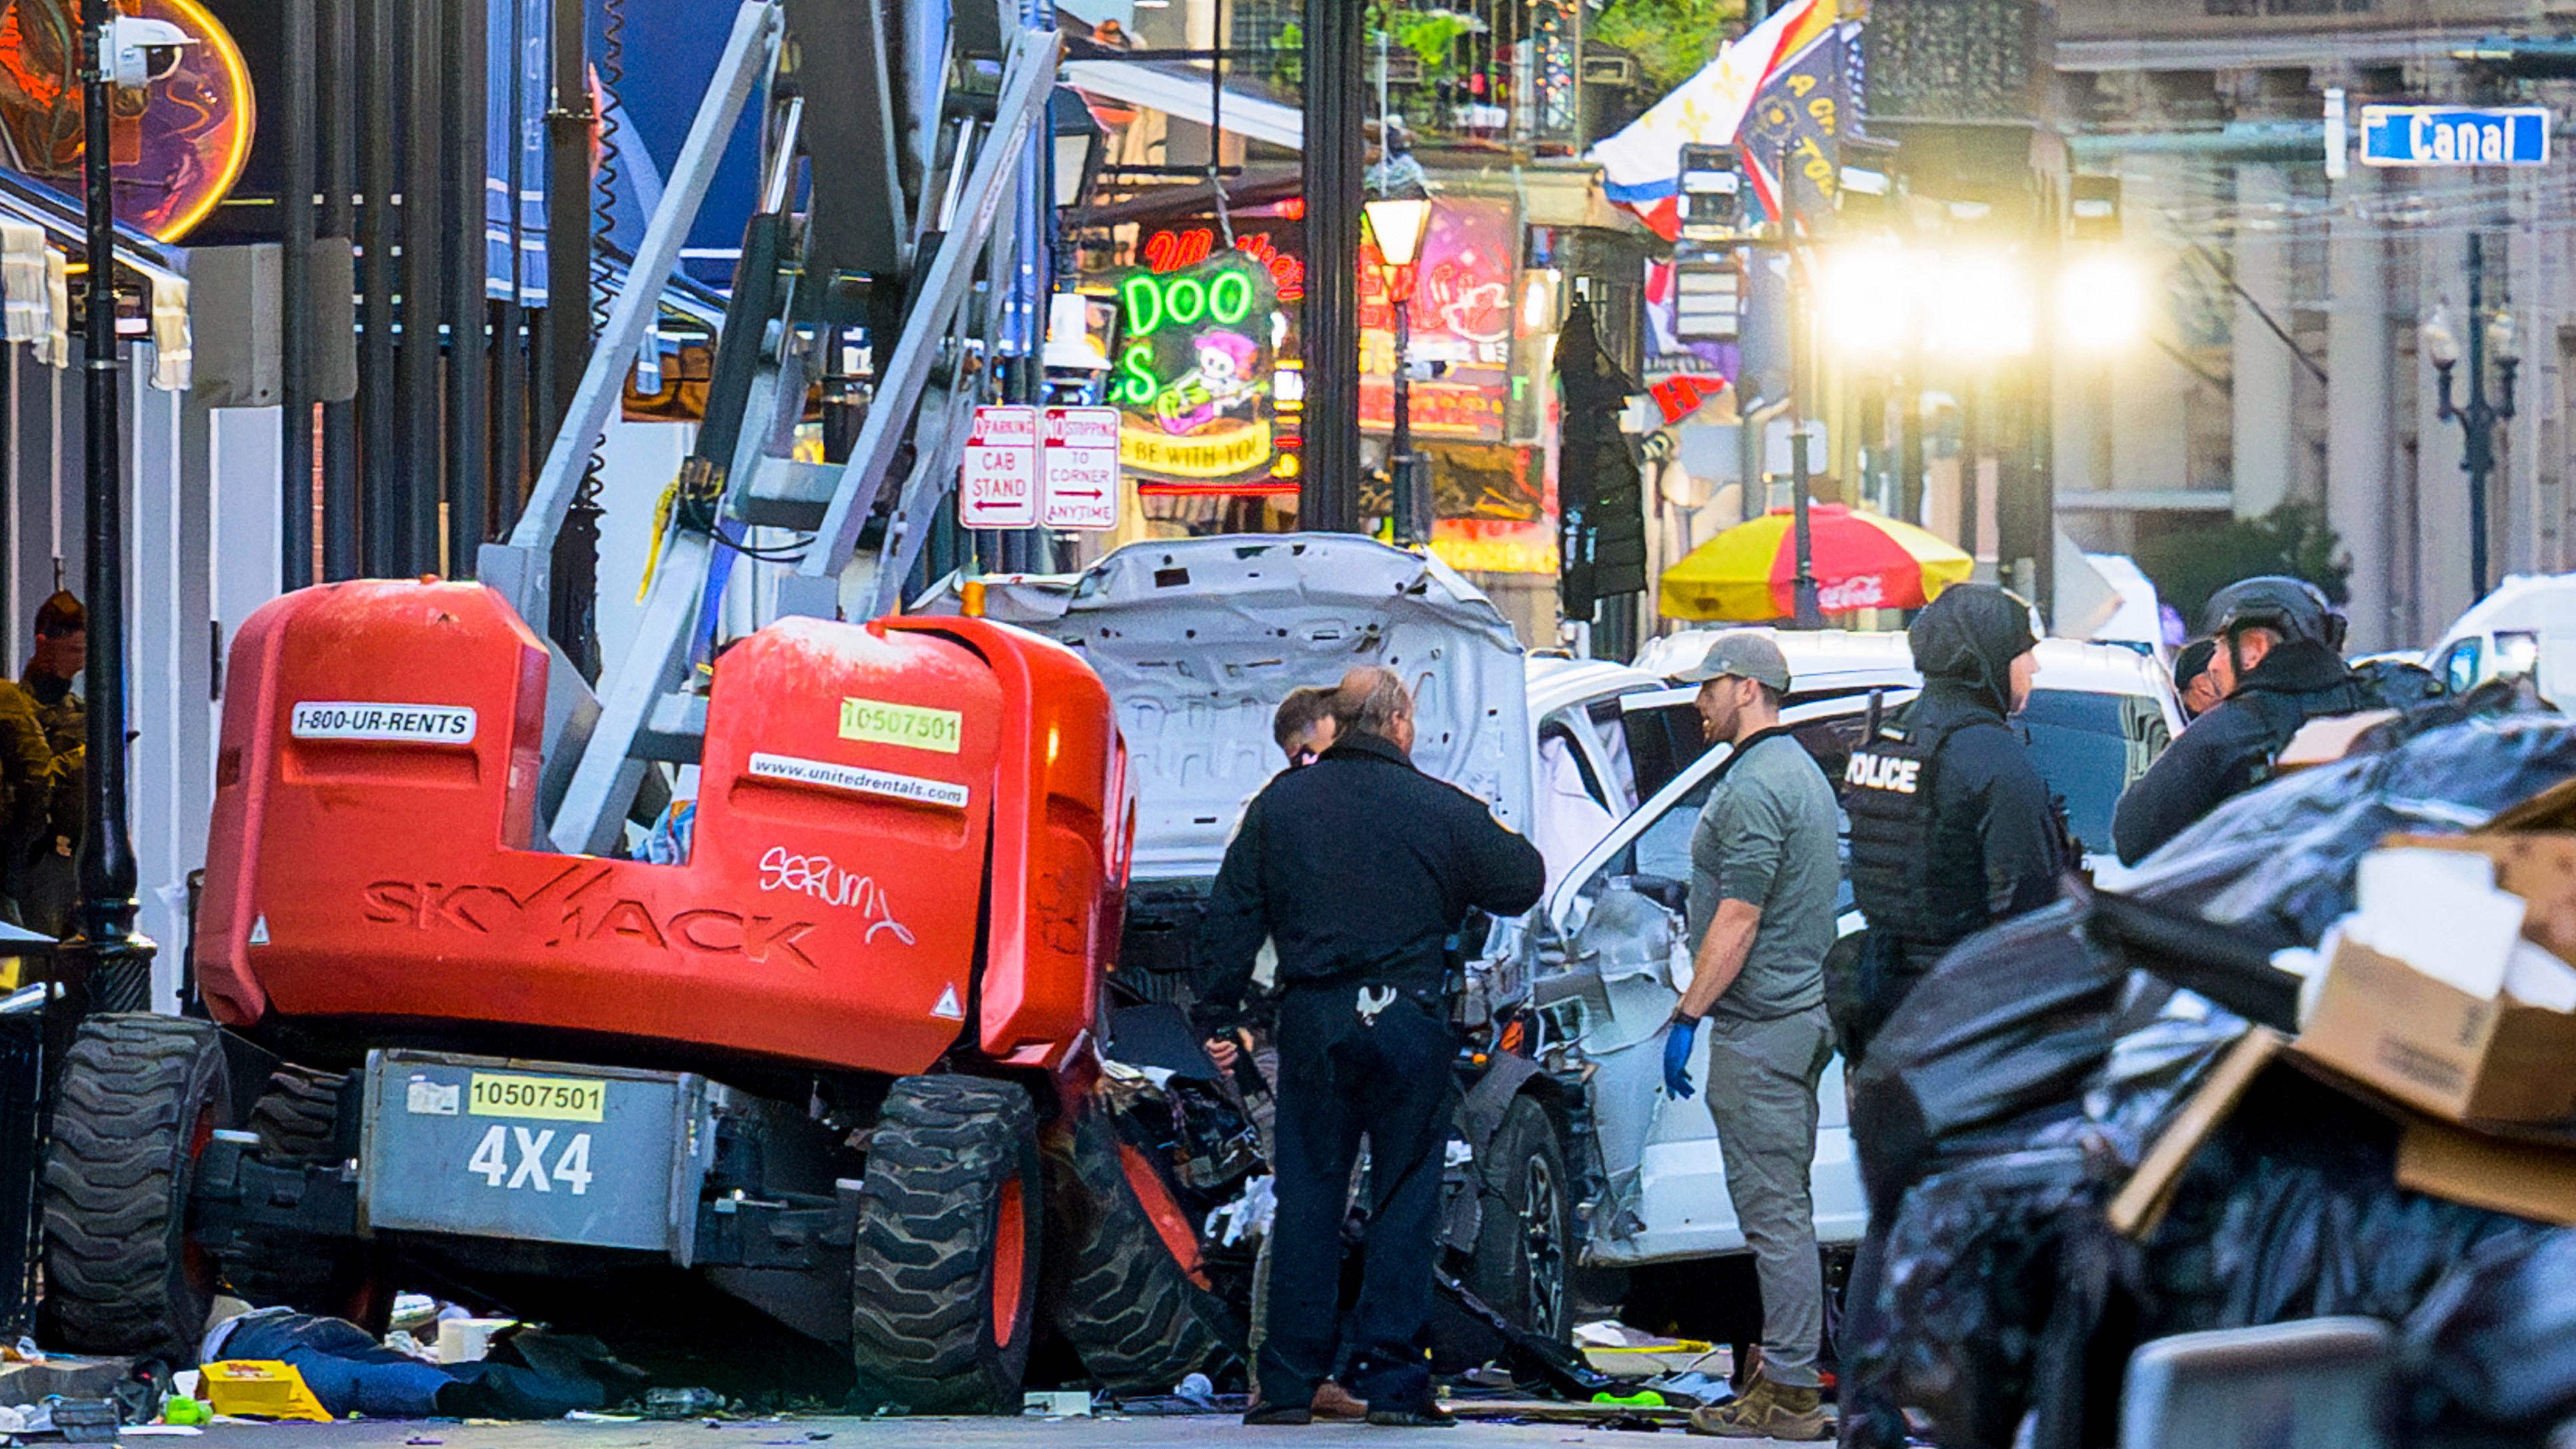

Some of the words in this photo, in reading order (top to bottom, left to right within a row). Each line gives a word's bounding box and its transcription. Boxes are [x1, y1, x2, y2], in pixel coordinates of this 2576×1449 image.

[2410, 112, 2515, 160] Canal
[984, 419, 1034, 434] PARKING
[1065, 421, 1115, 437] STOPPING
[982, 452, 1015, 471] CAB
[1071, 451, 1089, 465] TO
[1135, 441, 1159, 463] BE
[1166, 445, 1216, 468] WITH
[1050, 469, 1110, 483] CORNER
[972, 478, 1026, 497] STAND
[1047, 505, 1111, 521] ANYTIME
[297, 710, 466, 734] 1-800-UR-RENTS
[842, 706, 957, 741] 10507501
[755, 759, 962, 803] www.unitedrentals.com
[363, 863, 819, 970] SKYJACK
[473, 1081, 600, 1111] 10507501
